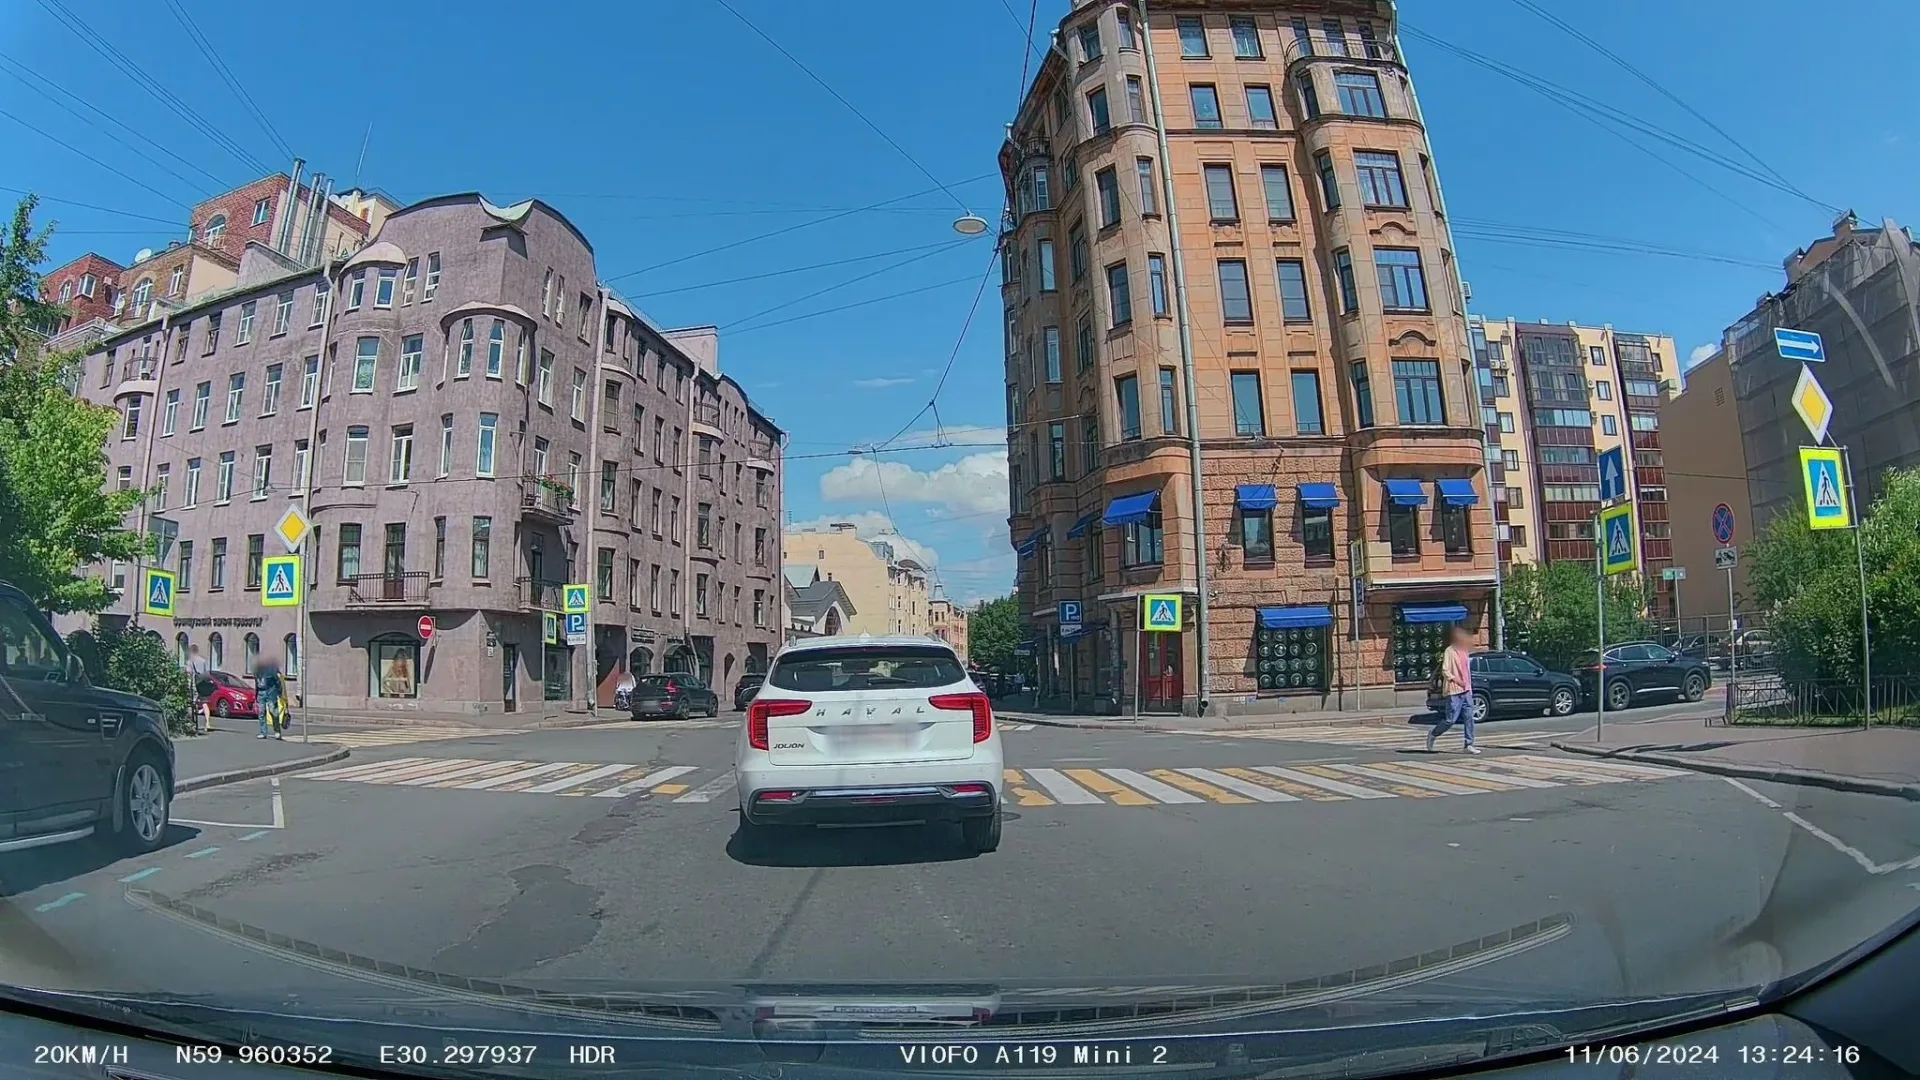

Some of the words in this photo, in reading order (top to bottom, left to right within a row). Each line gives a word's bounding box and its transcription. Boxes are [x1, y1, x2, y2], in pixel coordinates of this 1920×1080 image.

[1065, 603, 1077, 620] P
[571, 614, 582, 631] P
[815, 706, 925, 718] HAVAL
[773, 742, 805, 750] JOLION
